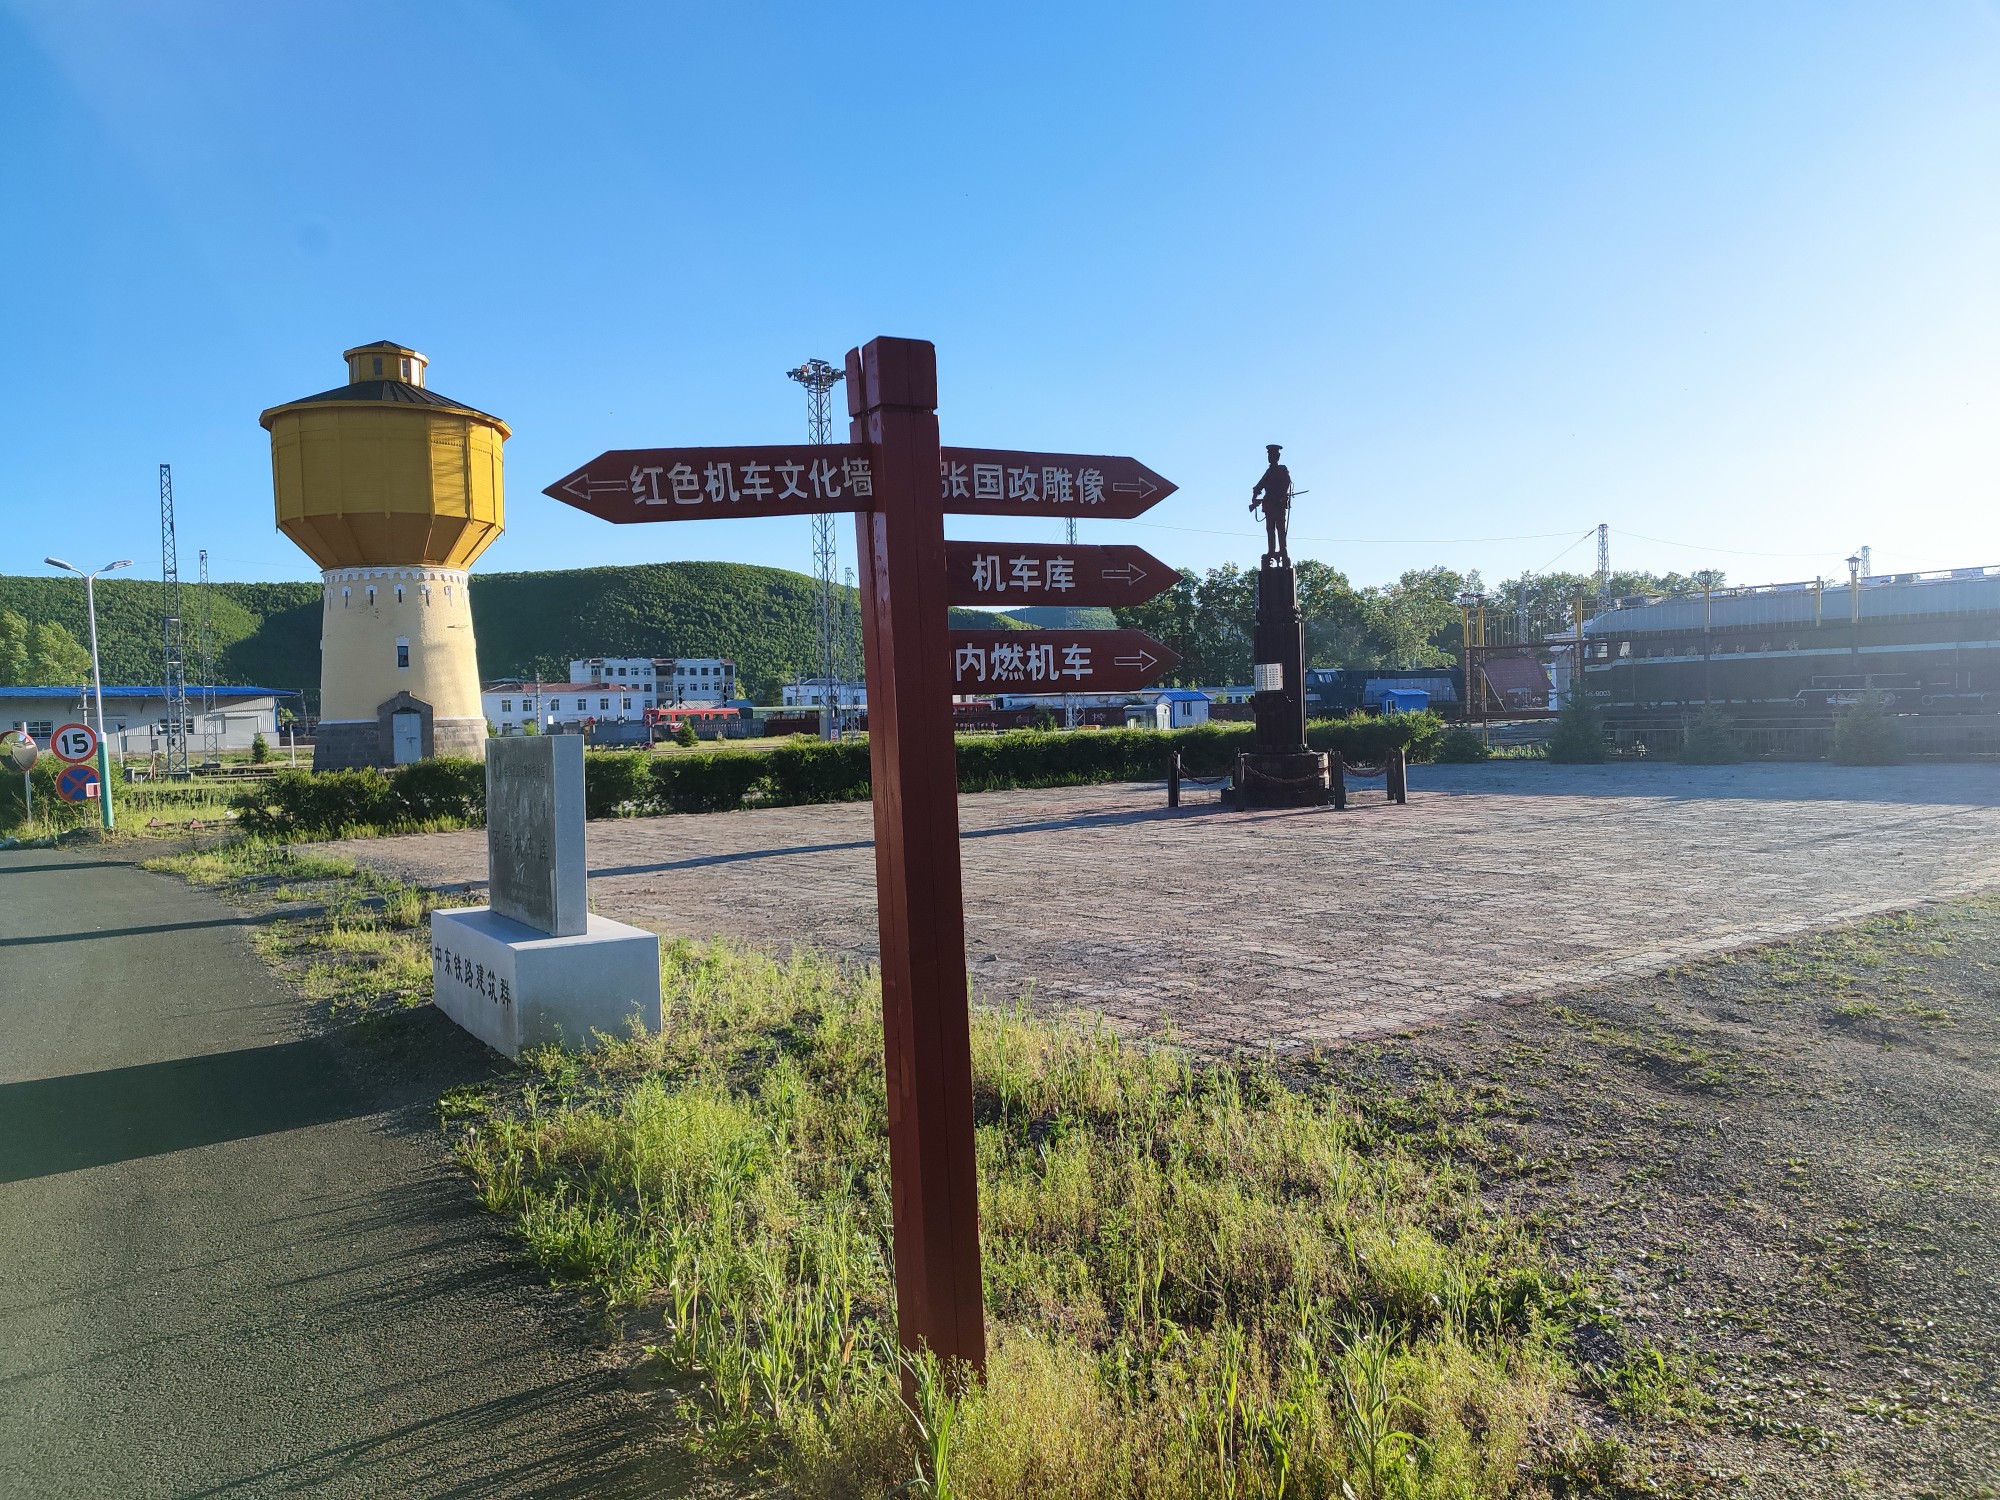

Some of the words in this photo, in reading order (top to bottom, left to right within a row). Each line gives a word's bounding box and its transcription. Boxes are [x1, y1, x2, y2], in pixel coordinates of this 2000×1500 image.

[629, 457, 873, 505] 红色机车文化墙
[941, 461, 1106, 505] 张国政雕像
[972, 553, 1076, 593] 机车库
[955, 642, 1093, 682] 内燃机车
[61, 733, 89, 755] 15
[434, 942, 512, 1012] 中东铁路建筑群
